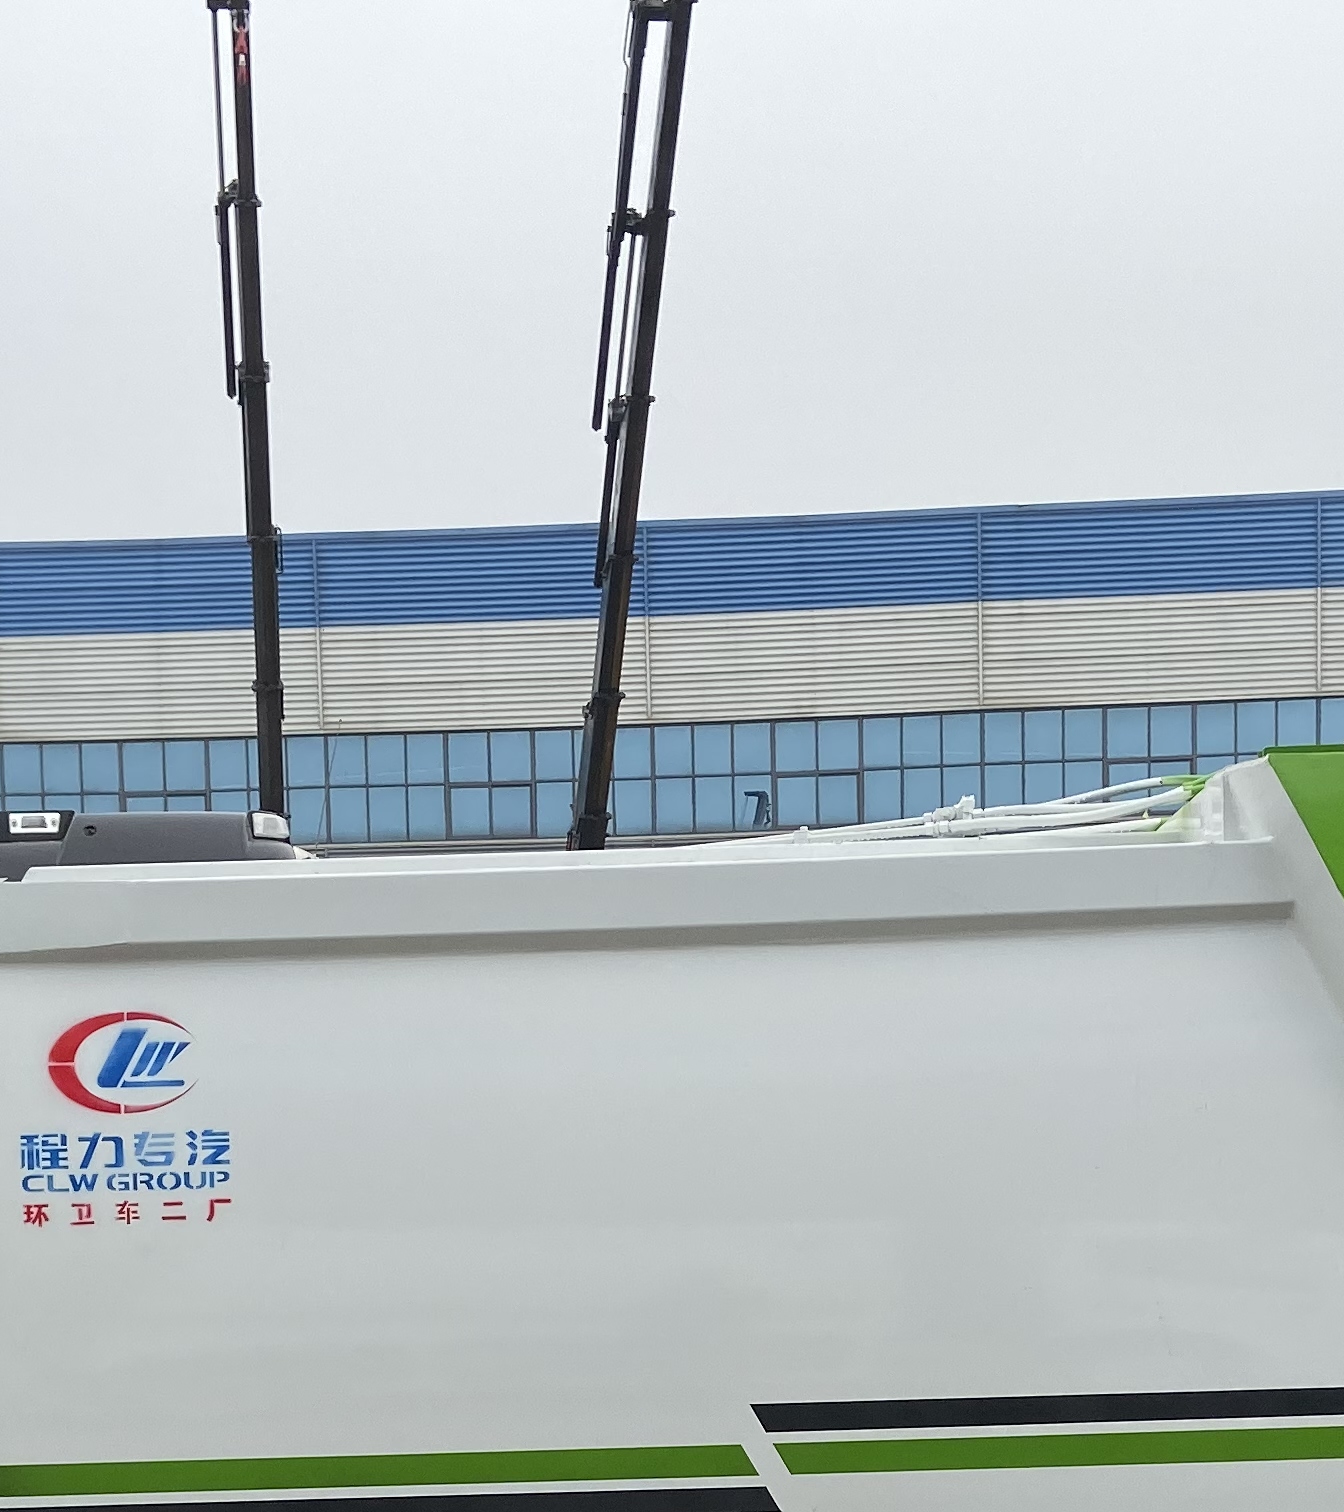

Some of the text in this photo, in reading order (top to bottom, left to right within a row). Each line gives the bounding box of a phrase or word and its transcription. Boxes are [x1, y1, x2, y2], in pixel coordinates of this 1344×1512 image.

[20, 1129, 231, 1170] 程力专汽
[22, 1171, 231, 1192] CLW GROUP
[23, 1198, 232, 1227] 环卫车二厂
